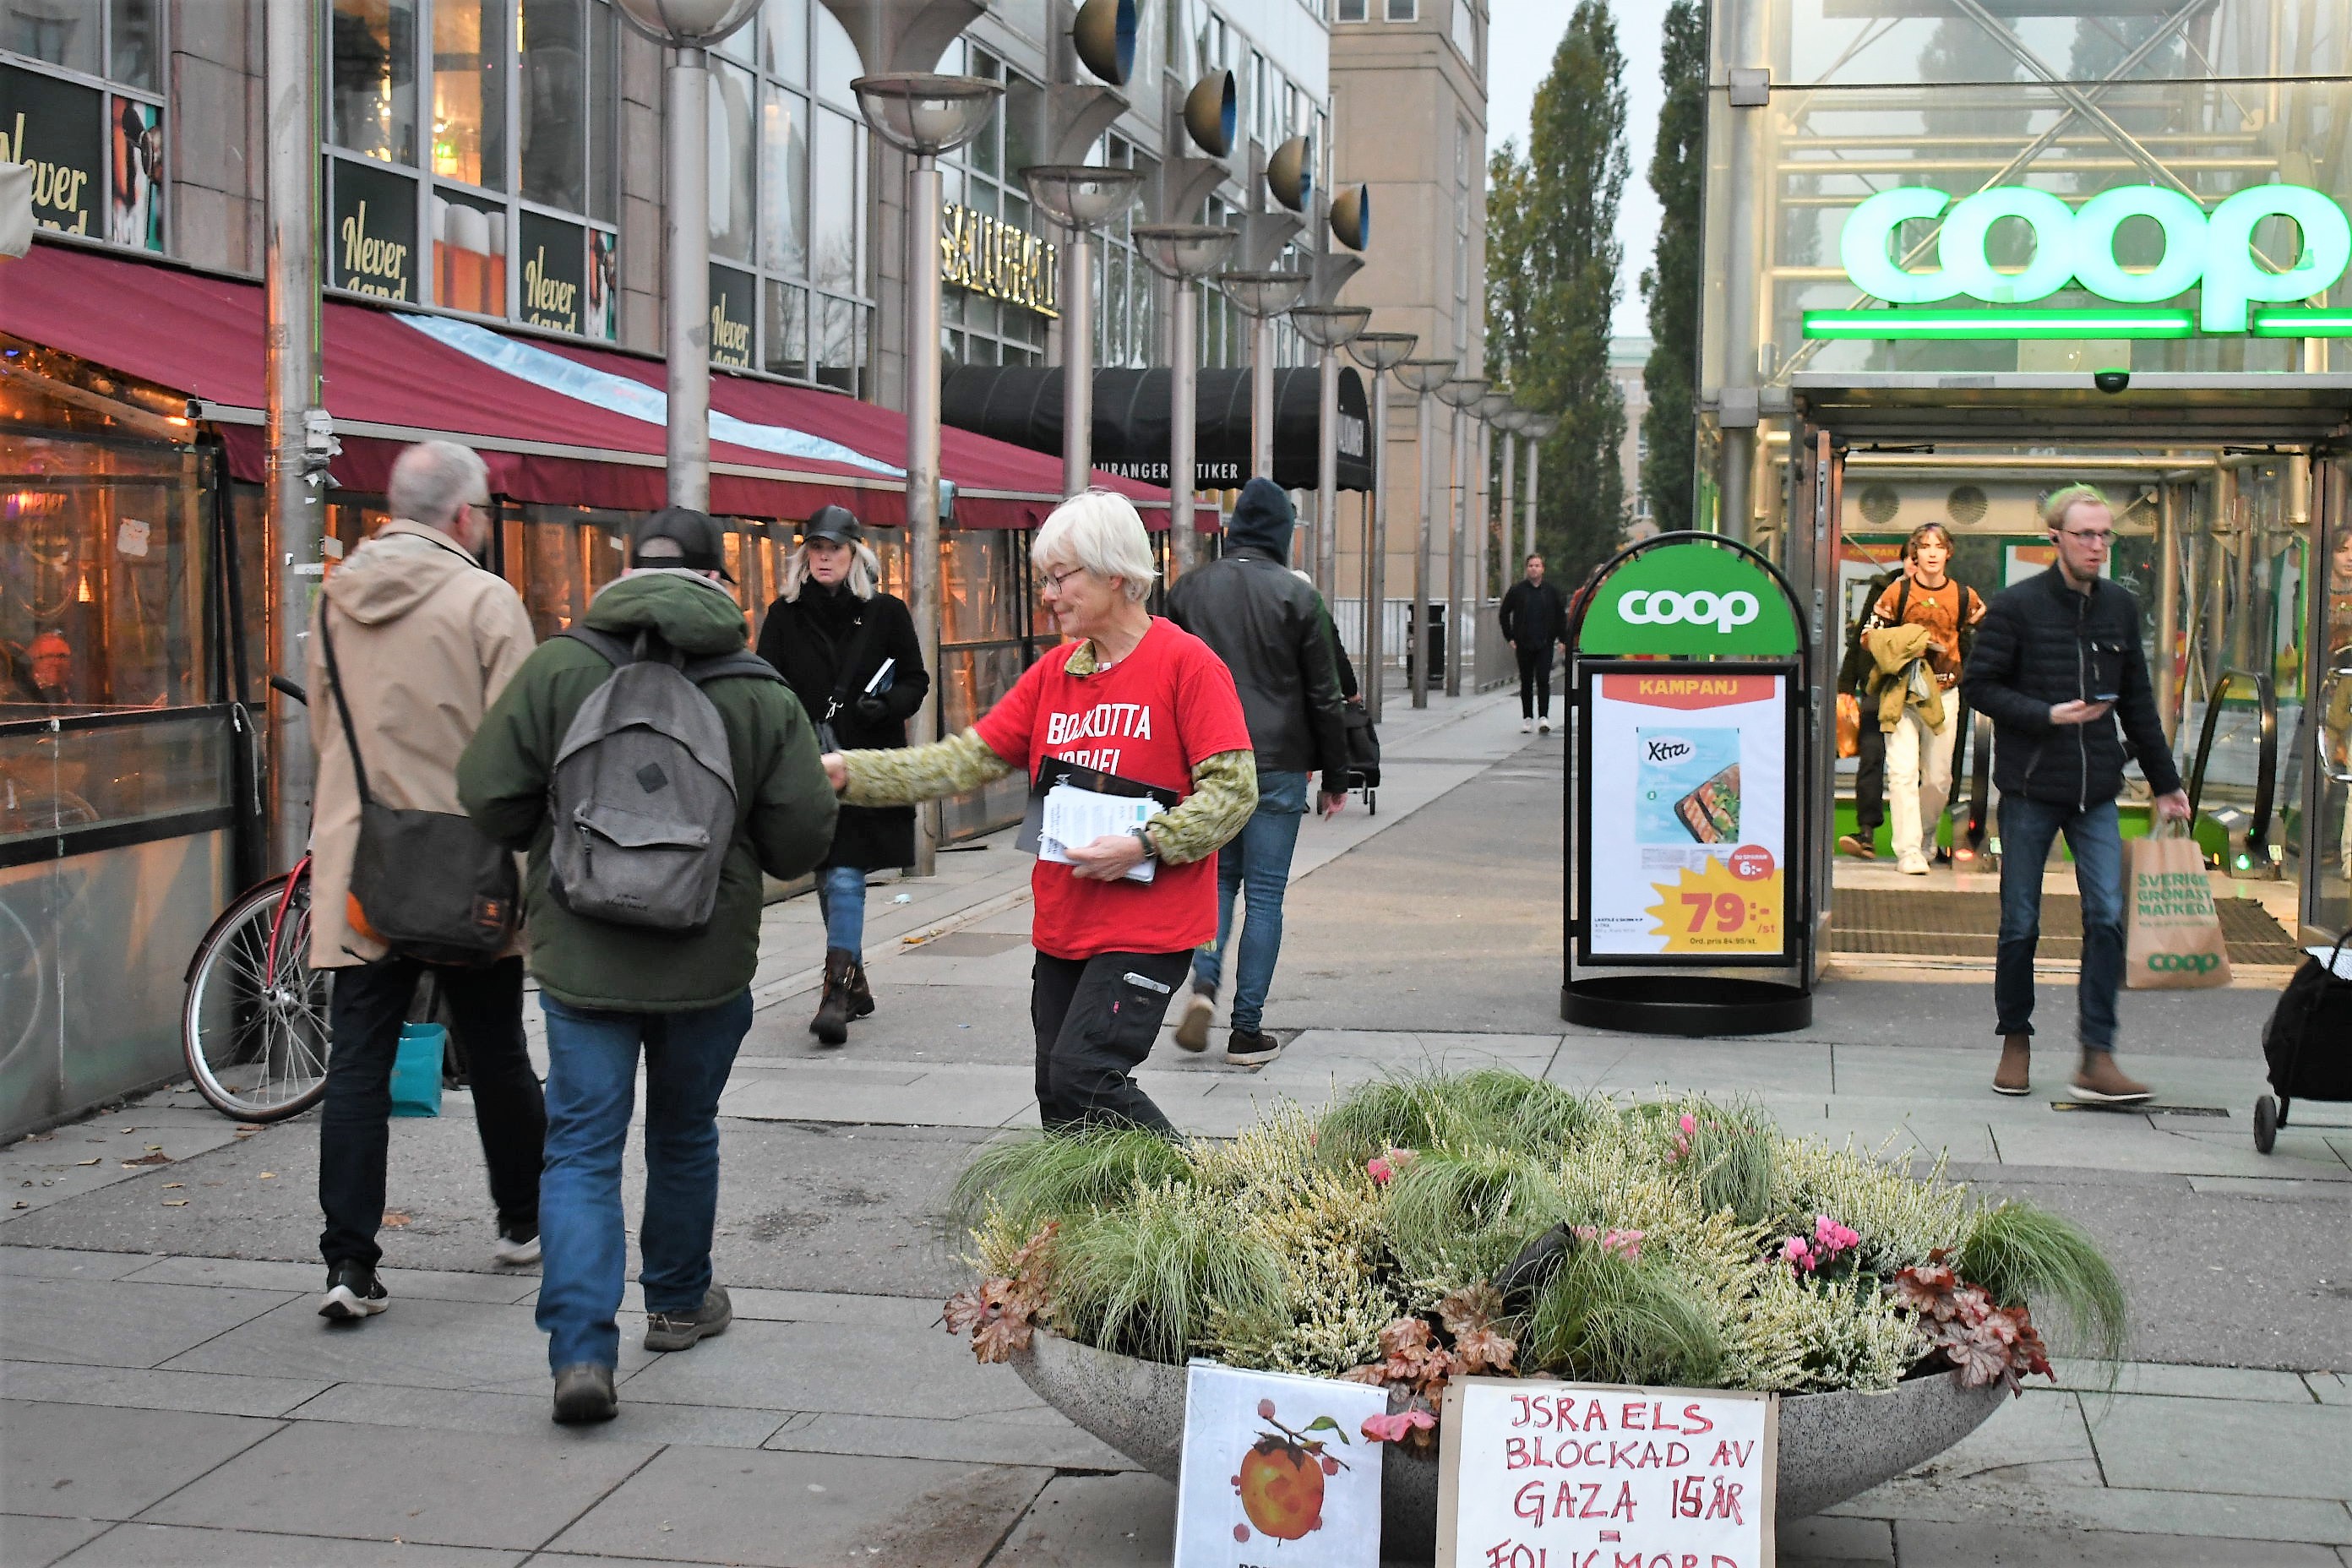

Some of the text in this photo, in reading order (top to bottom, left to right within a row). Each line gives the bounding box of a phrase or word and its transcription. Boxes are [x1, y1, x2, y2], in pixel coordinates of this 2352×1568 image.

[342, 200, 406, 280] Never
[1840, 184, 2351, 333] coop
[525, 245, 576, 314] Never
[712, 293, 749, 352] Never
[1195, 463, 1239, 479] TIKER
[1617, 590, 1760, 634] coop
[1639, 679, 1739, 695] KAMPANJ
[1648, 741, 1690, 761] Xtra
[2148, 952, 2221, 976] coop
[1506, 1436, 1755, 1470] BLOCKAD AV
[1513, 1475, 1744, 1528] GAZA 15 ÅR
